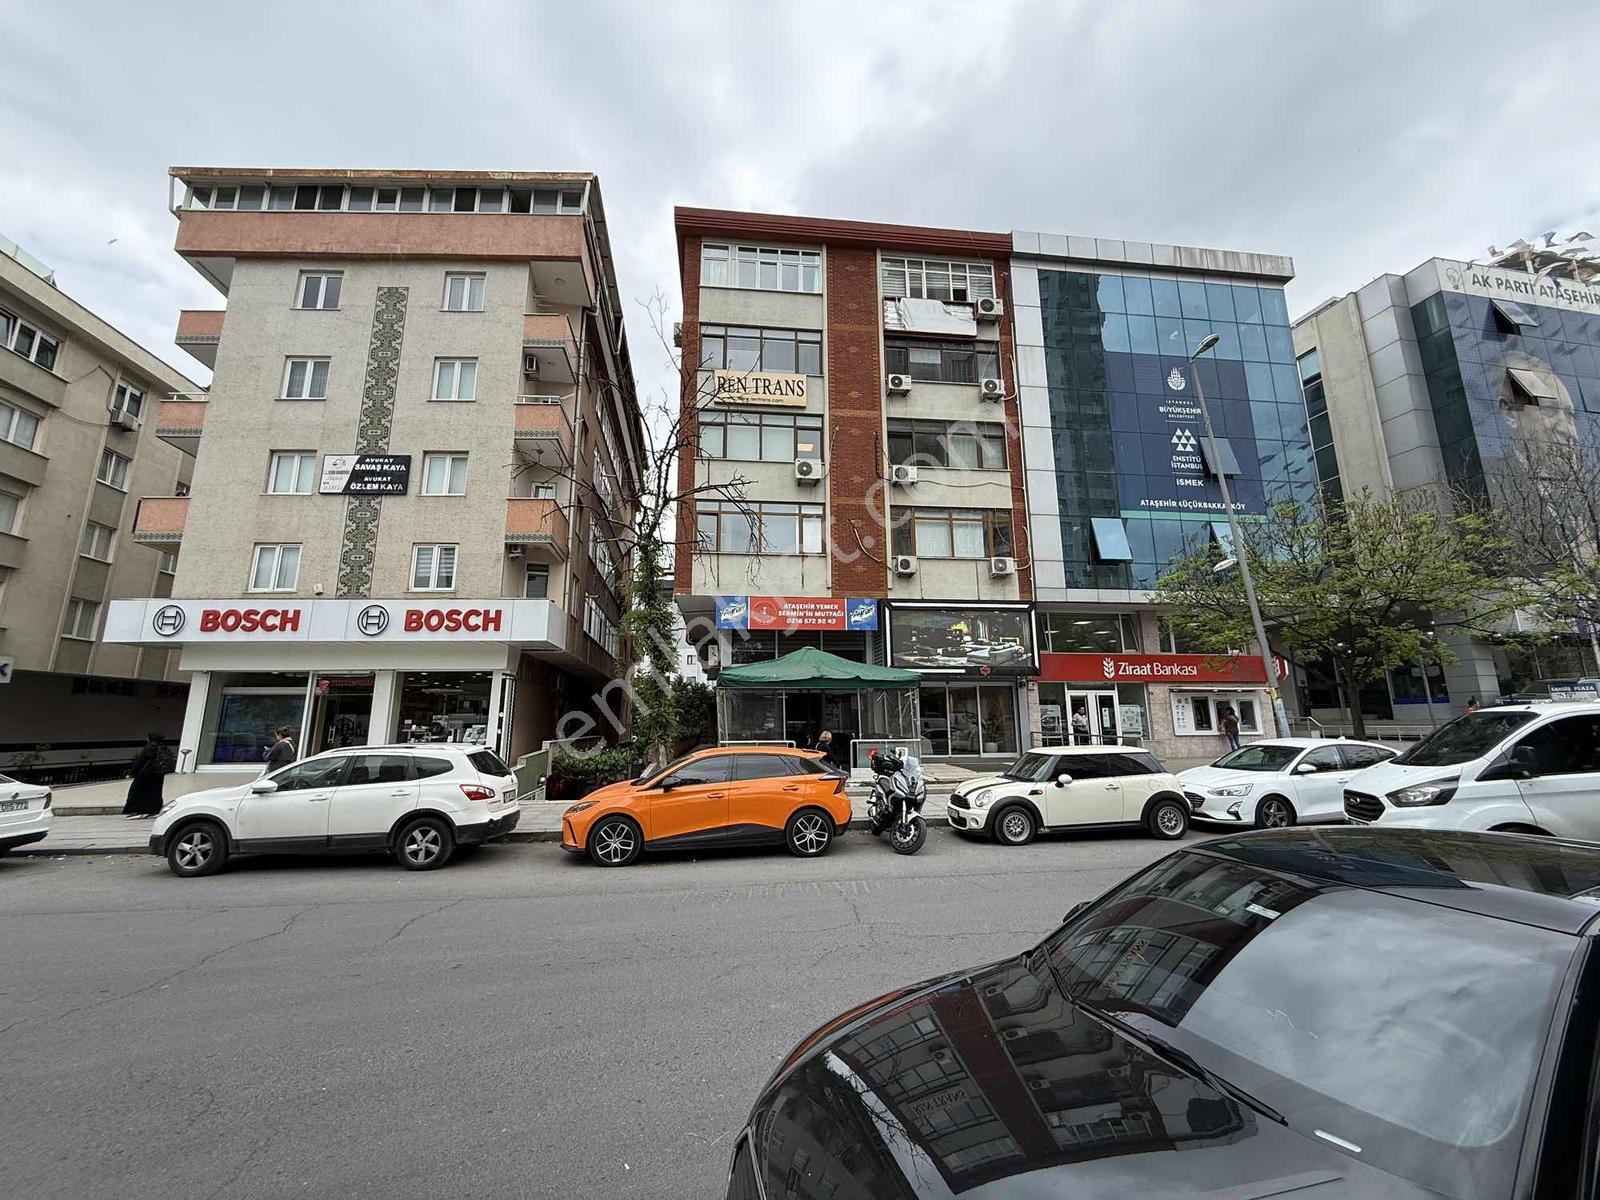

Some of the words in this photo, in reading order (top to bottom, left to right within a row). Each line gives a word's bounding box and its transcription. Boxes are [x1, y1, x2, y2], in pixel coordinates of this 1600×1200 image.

[1472, 273, 1492, 288] AK
[1495, 278, 1535, 295] PARTİ
[717, 376, 748, 393] REN
[752, 378, 804, 397] TRANS
[355, 464, 382, 472] SAVAŞ
[350, 482, 379, 490] ÖZLEM
[1140, 499, 1177, 508] ATAŞEHİR
[200, 609, 300, 632] BOSCH
[404, 609, 501, 632] BOSCH
[1118, 662, 1151, 675] Ziraat
[1153, 662, 1197, 675] Bankası
